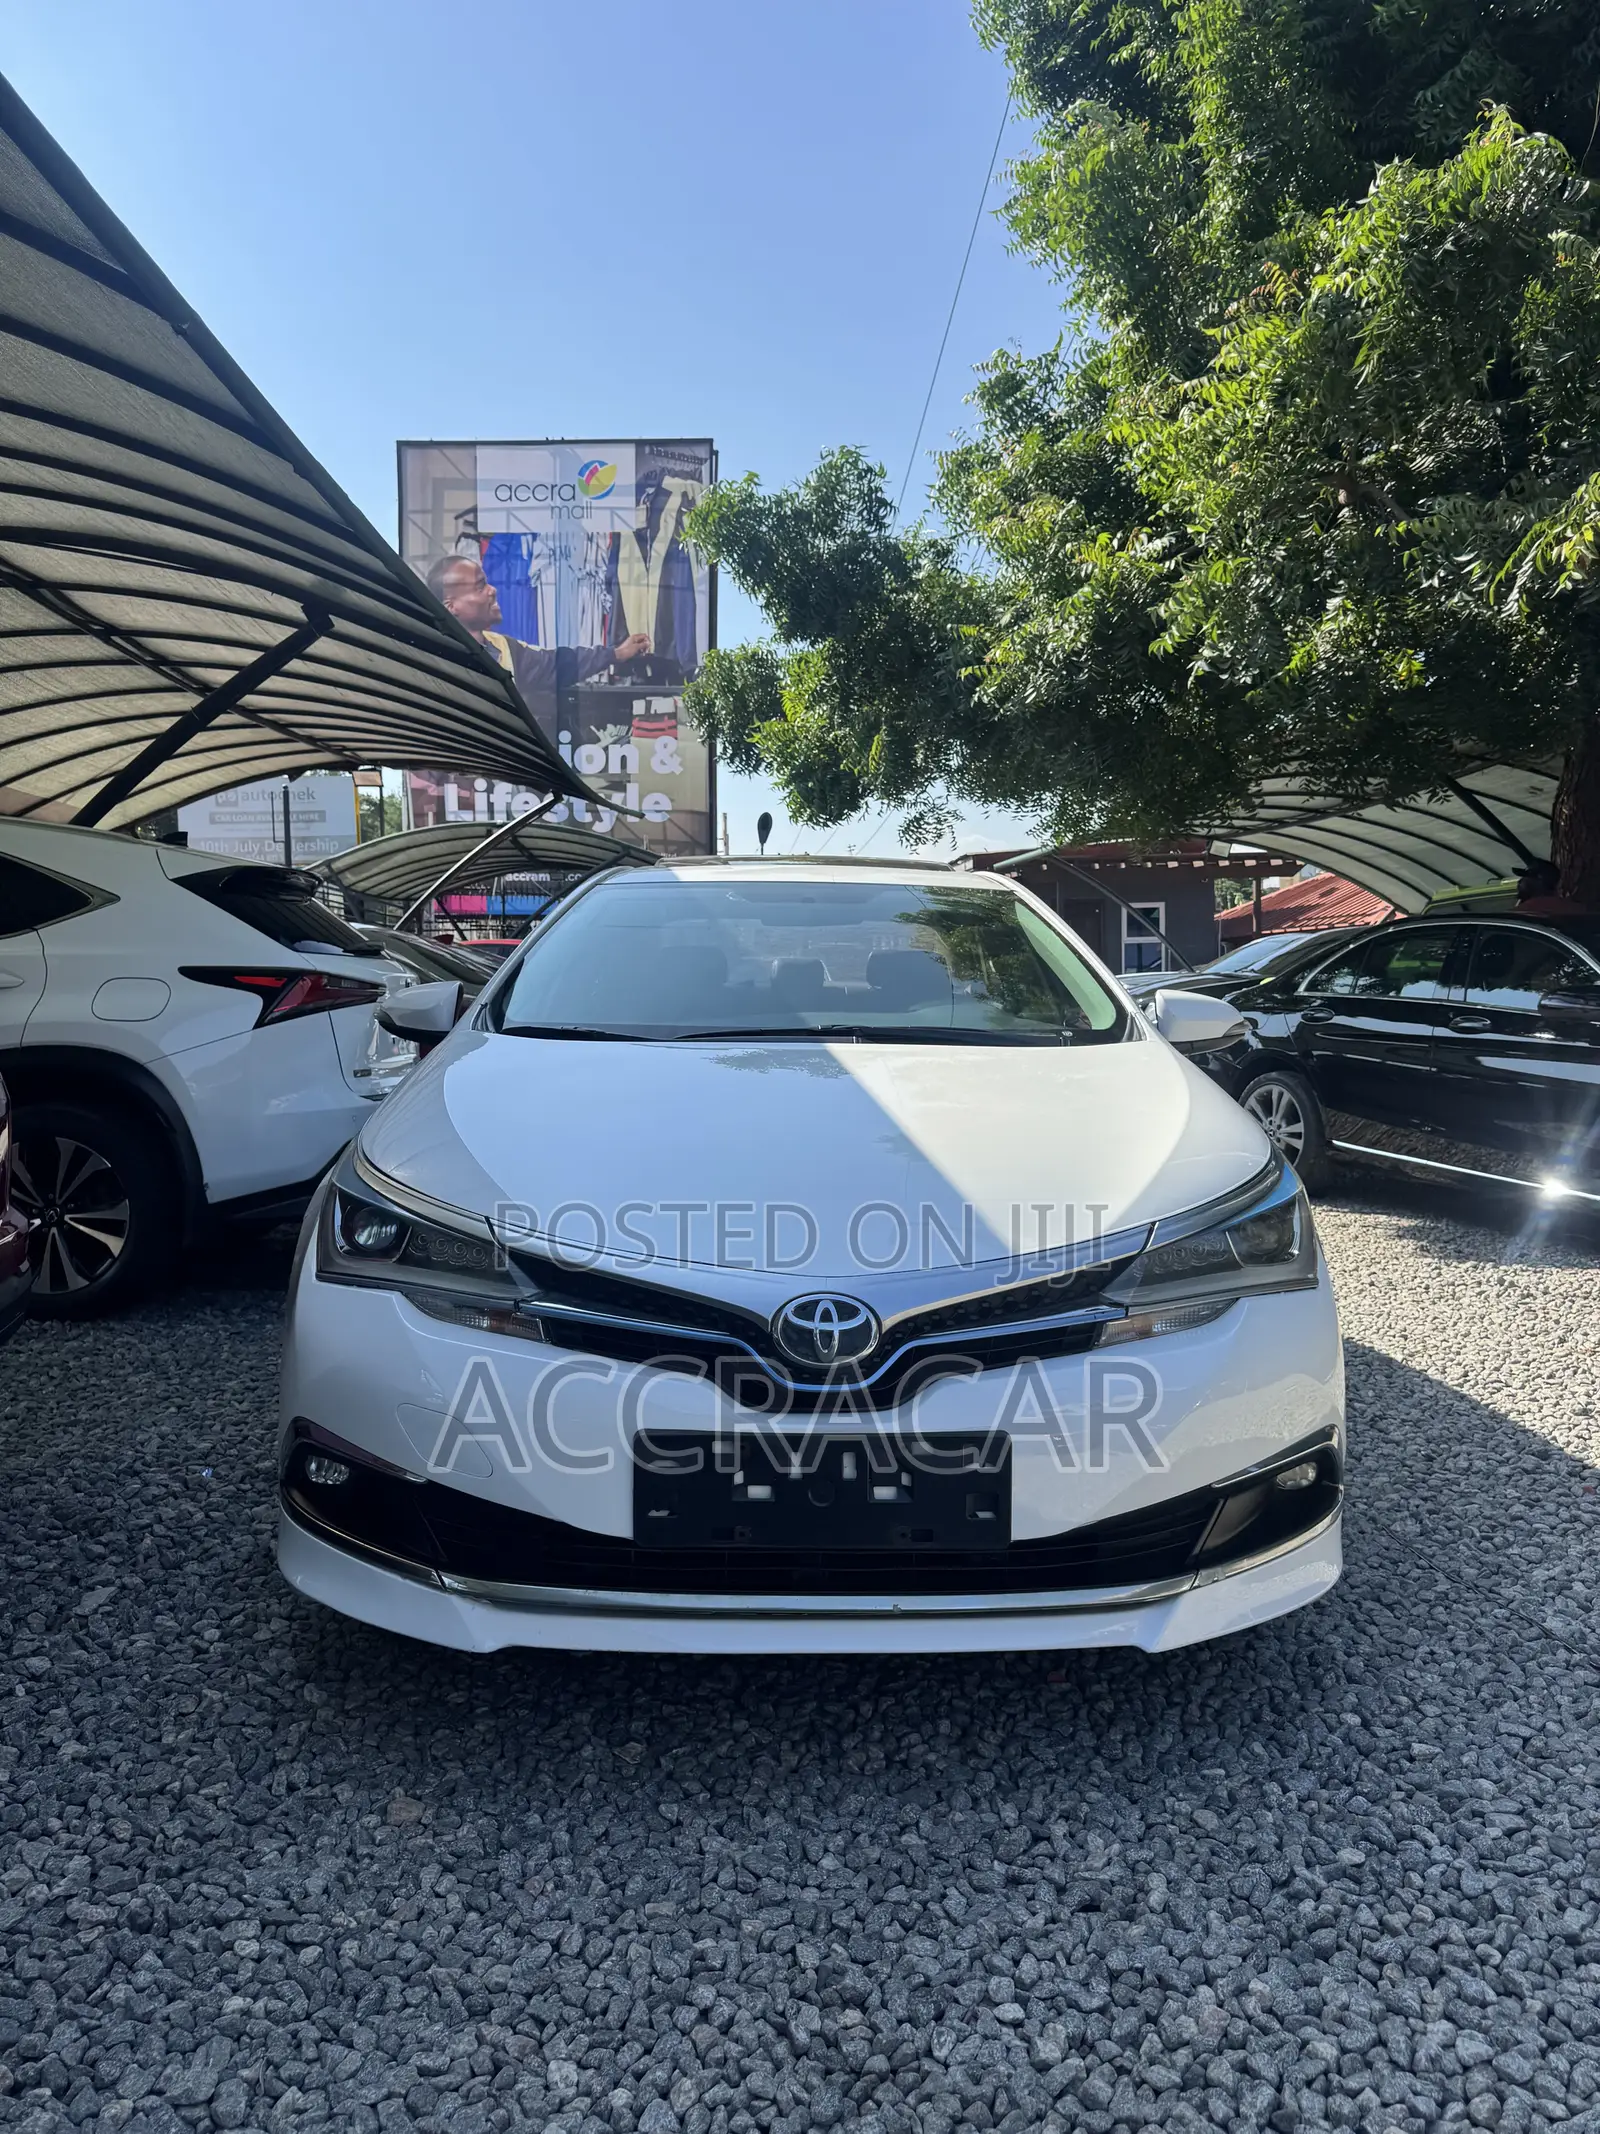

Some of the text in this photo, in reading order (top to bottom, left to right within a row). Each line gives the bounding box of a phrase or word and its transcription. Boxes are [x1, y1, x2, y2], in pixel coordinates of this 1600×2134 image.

[494, 484, 577, 502] accra
[550, 500, 593, 520] mall
[651, 735, 684, 775] &
[233, 840, 258, 854] July
[264, 839, 340, 854] Delership
